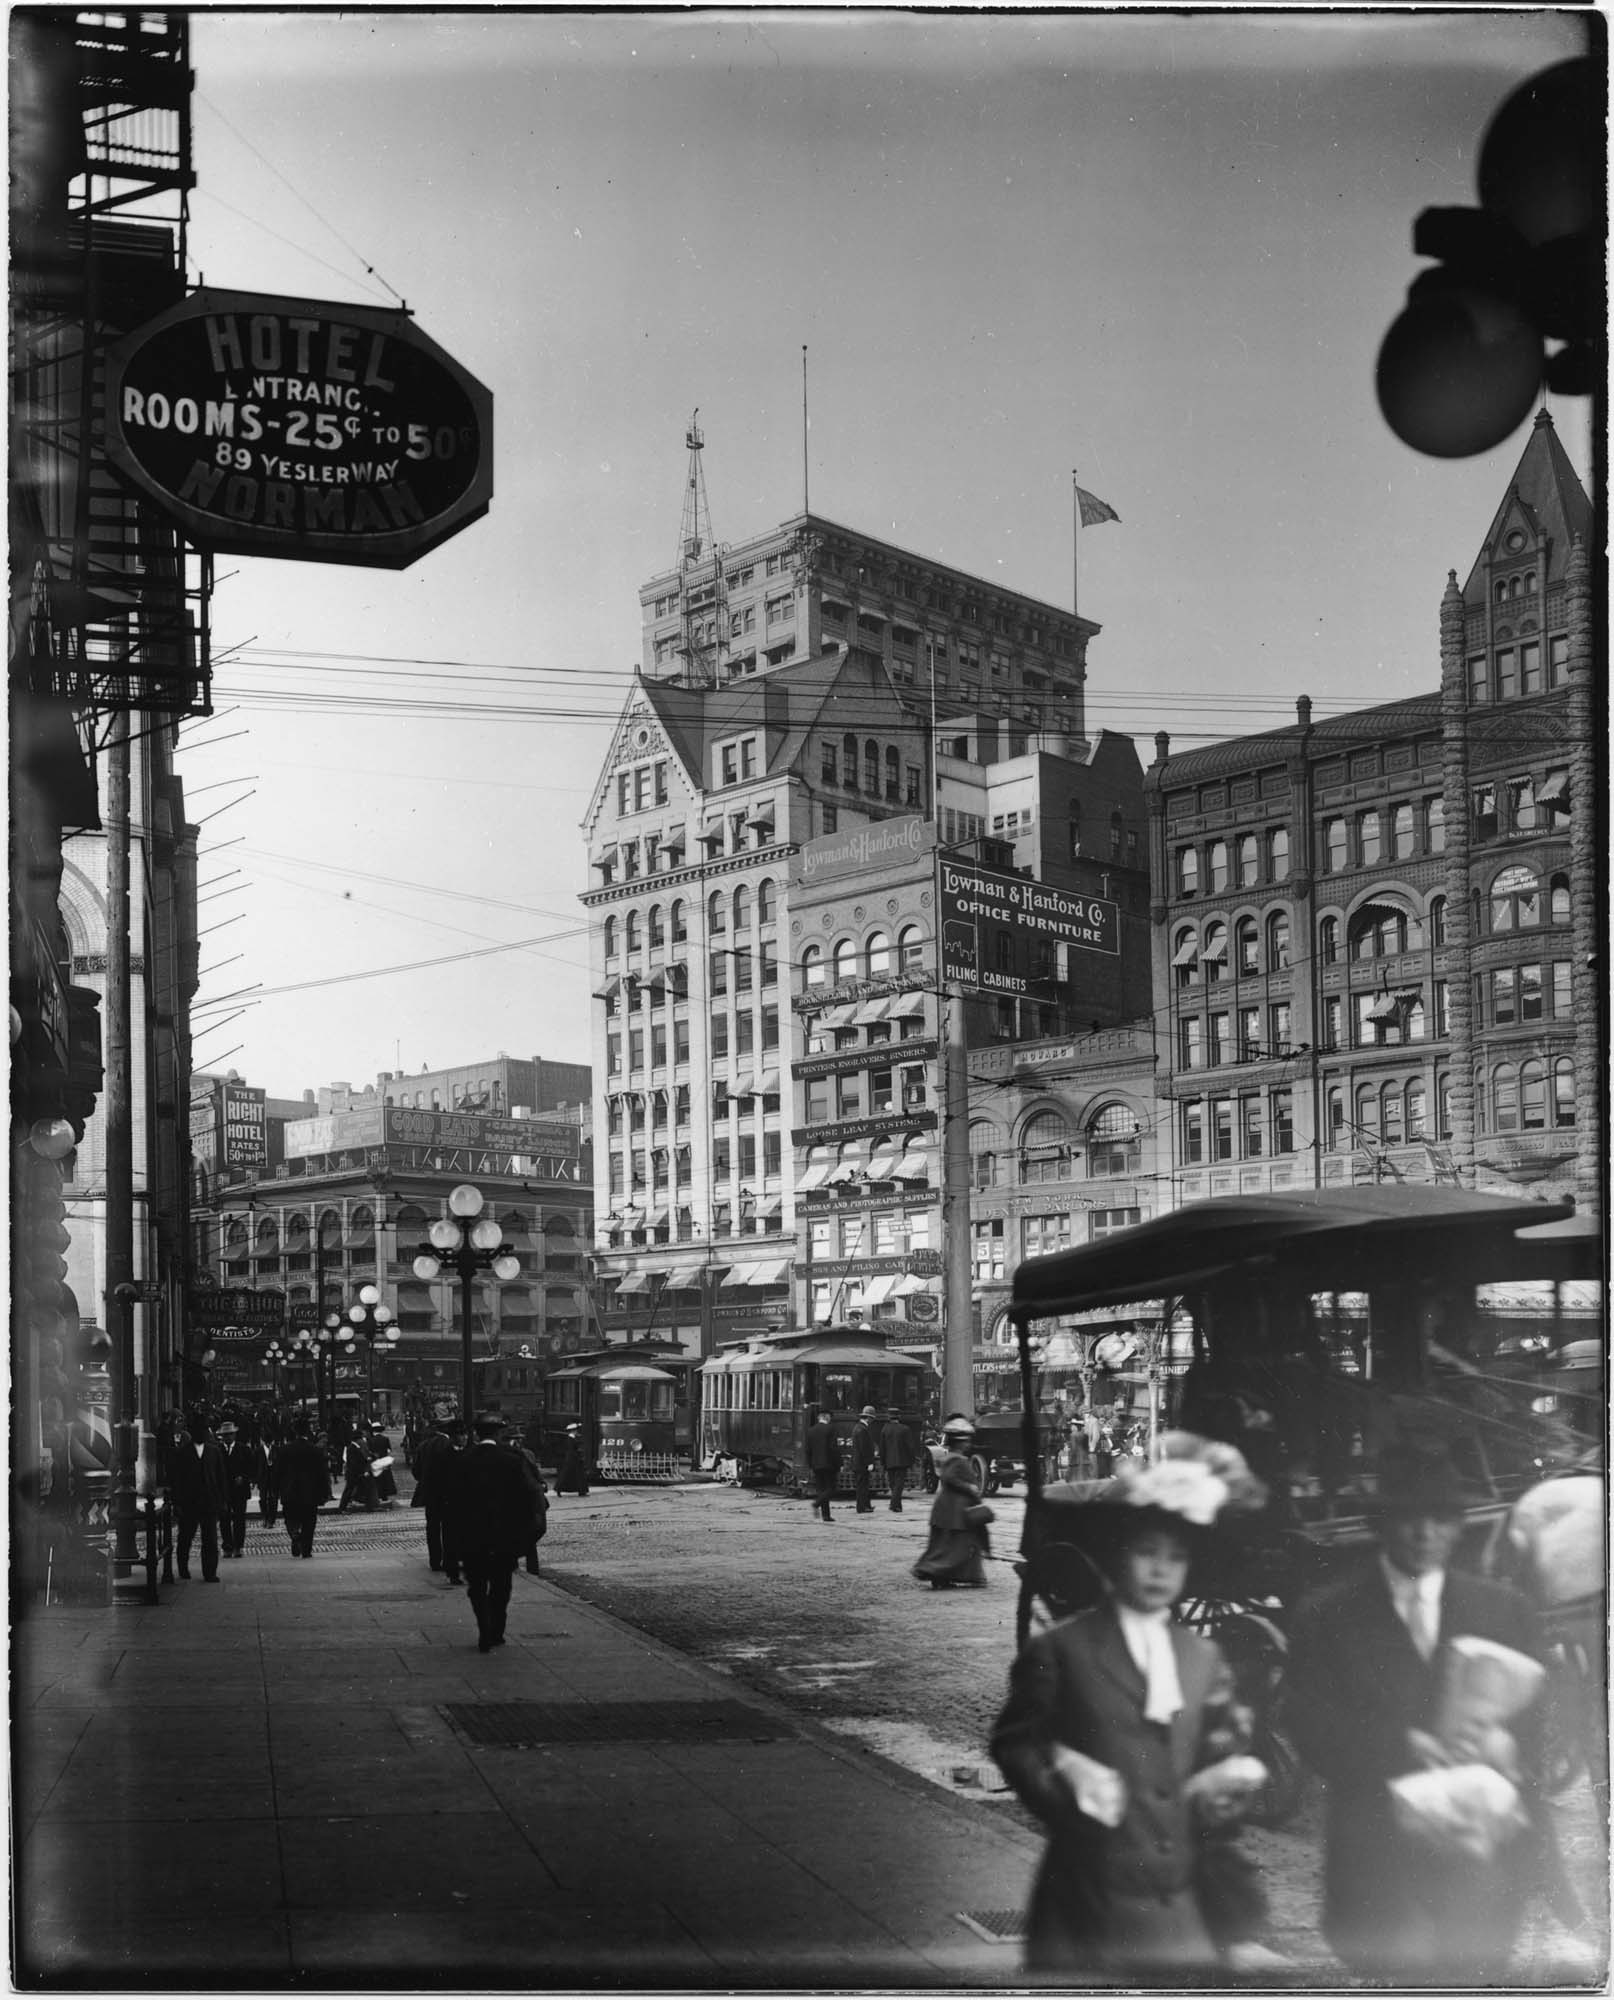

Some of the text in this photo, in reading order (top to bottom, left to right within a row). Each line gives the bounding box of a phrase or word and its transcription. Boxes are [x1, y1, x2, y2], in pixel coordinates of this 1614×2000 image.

[204, 315, 397, 393] HOTEL
[225, 376, 381, 417] NTRANC
[373, 425, 400, 444] TO
[215, 442, 252, 470] 89
[177, 459, 425, 533] NORMAN
[943, 866, 1005, 900] Lowman
[1009, 887, 1021, 903] &
[1022, 886, 1083, 918] Hanford
[956, 899, 1102, 943] OFFICE FURNITURE
[946, 963, 1027, 992] FILING CABINETS
[233, 1090, 256, 1101] THE
[227, 1100, 264, 1122] RIGHT
[227, 1124, 264, 1141] HOTEL
[391, 1110, 435, 1133] GOOD
[439, 1116, 481, 1138] EATS
[806, 1127, 838, 1140] LOOSE
[231, 1141, 260, 1151] RATES
[798, 1191, 937, 1212] CAMERAS AND PHOTOGRAPHIC SUPPLIES
[984, 1200, 1107, 1218] DENTAL PARLORS
[831, 1265, 848, 1274] AND
[209, 1327, 256, 1338] DENTISTS
